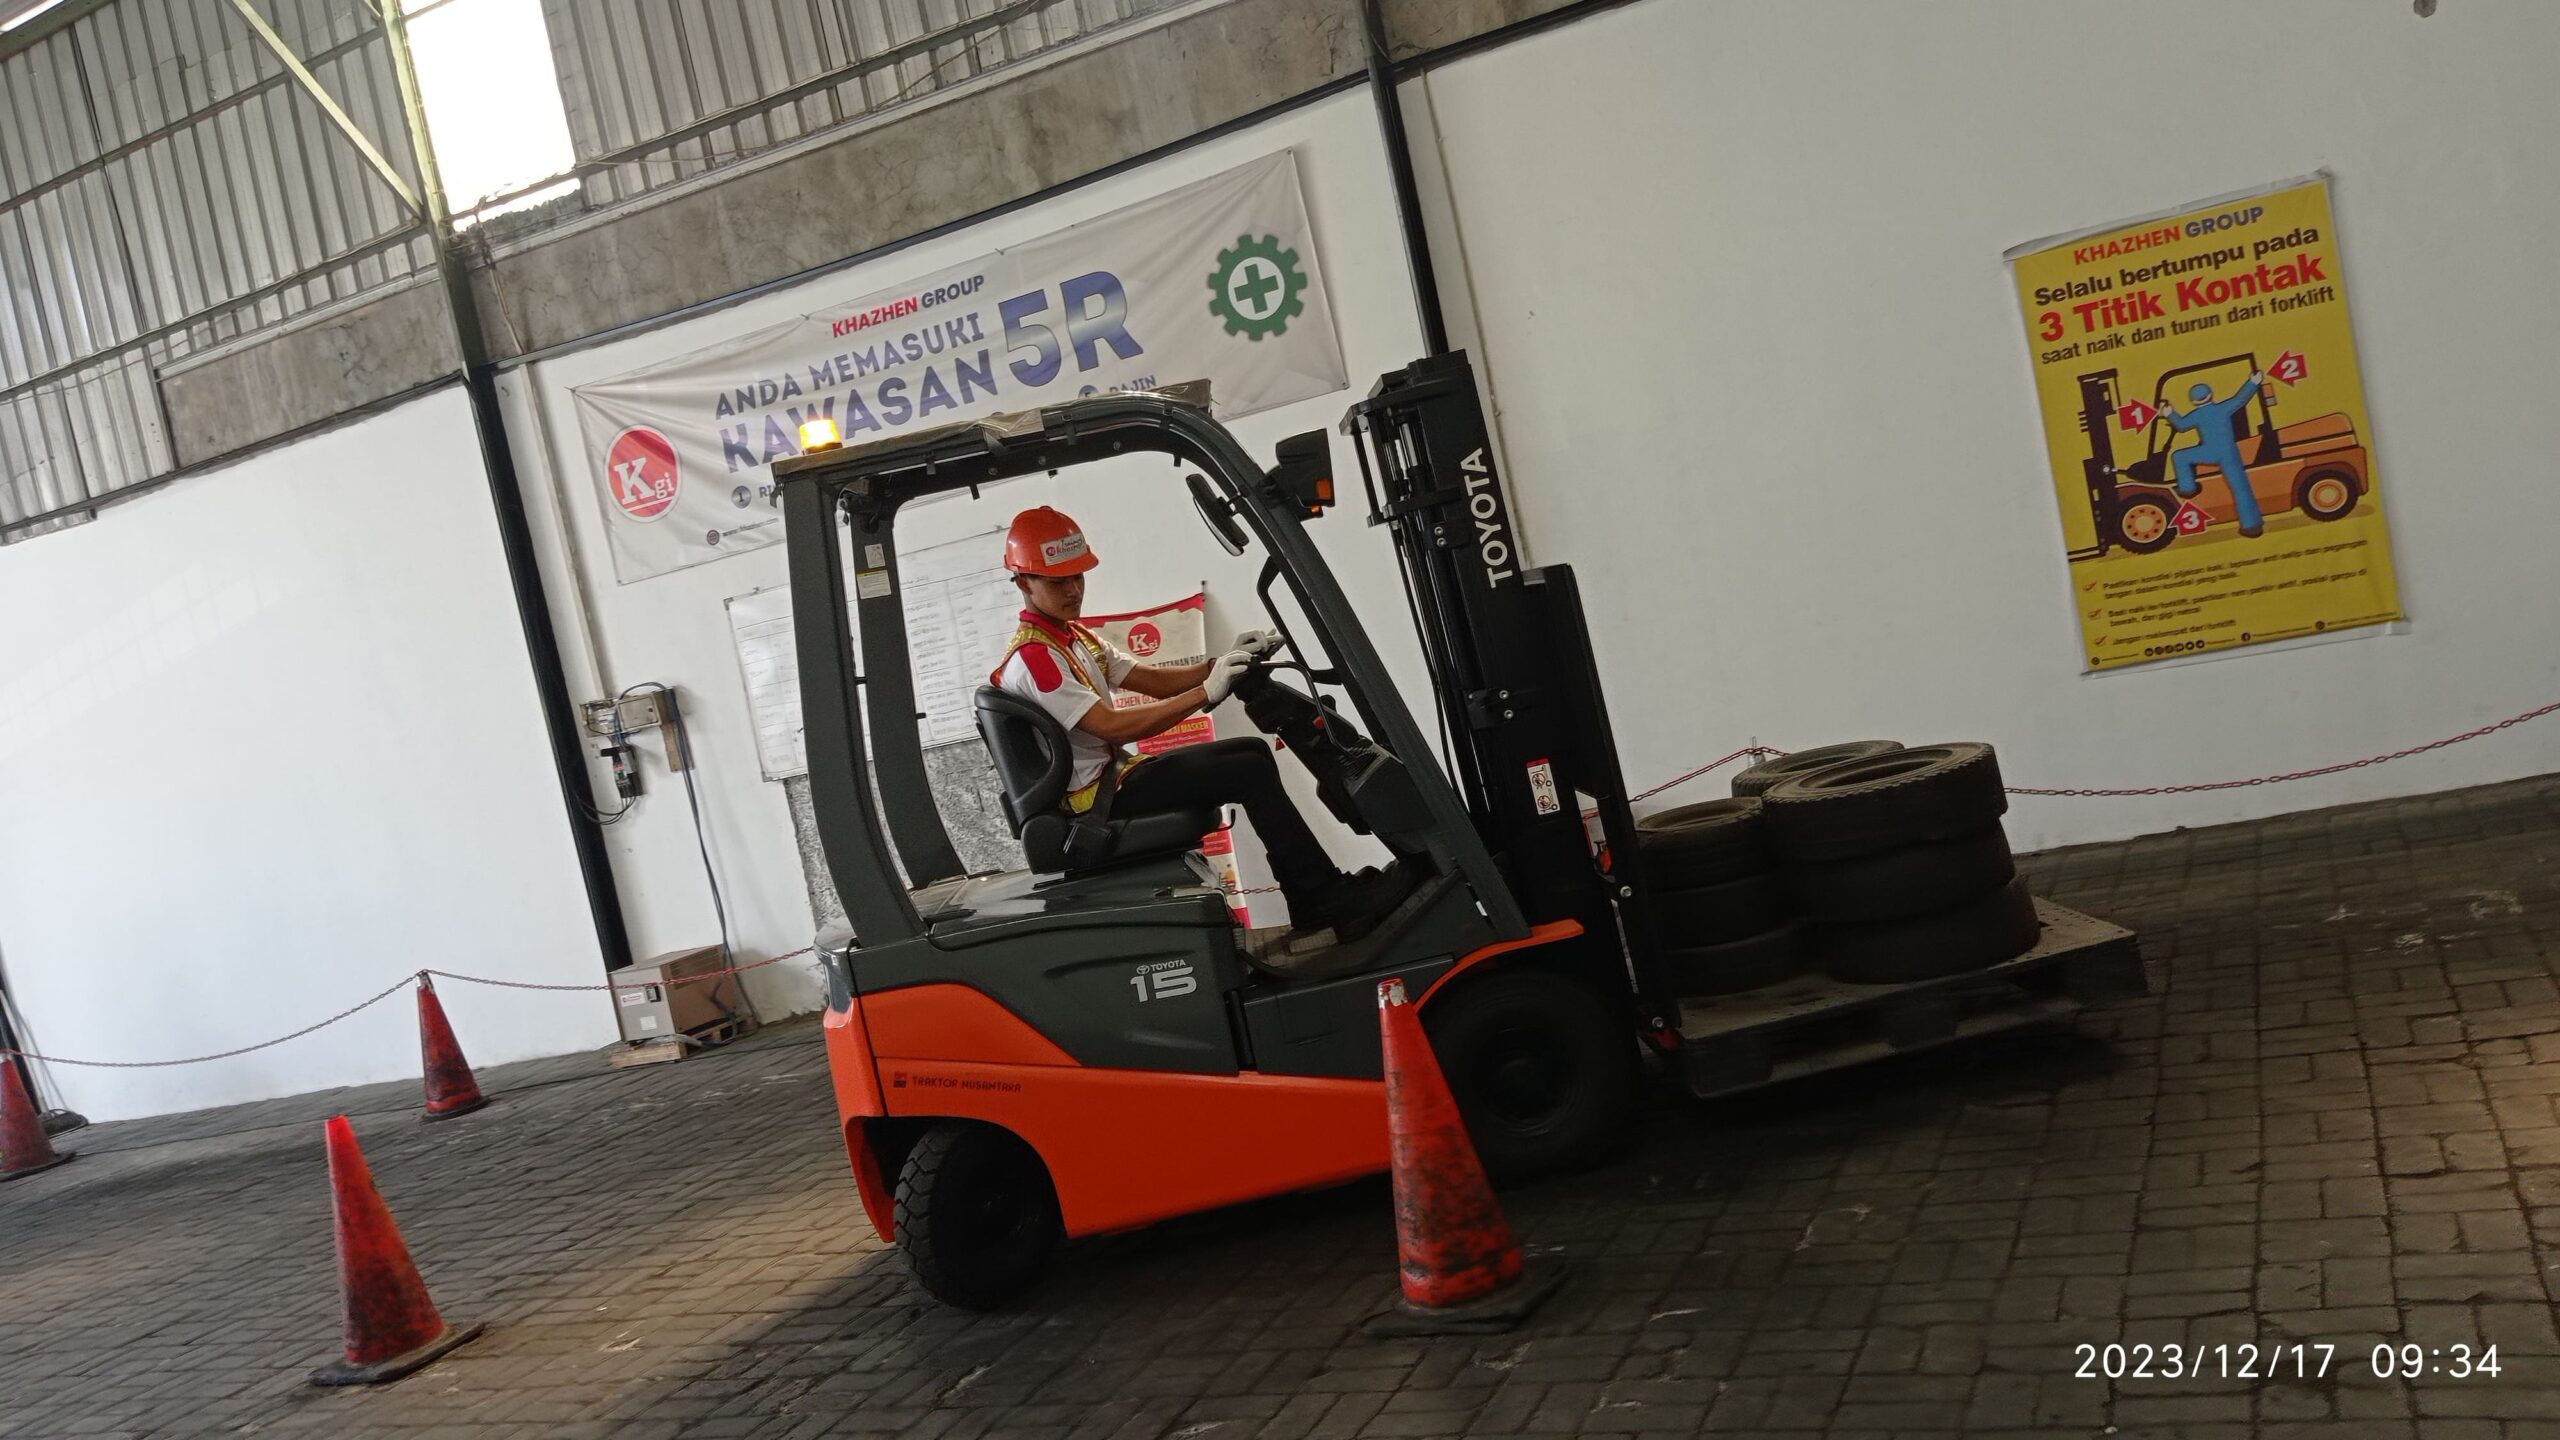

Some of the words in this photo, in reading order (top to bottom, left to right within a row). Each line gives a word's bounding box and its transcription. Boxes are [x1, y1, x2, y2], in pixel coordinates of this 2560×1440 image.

[2074, 225, 2182, 265] KHAZHEN
[2185, 205, 2264, 238] GROUP
[2034, 277, 2112, 306] Selalu
[2120, 246, 2245, 289] bertumpu
[2254, 227, 2319, 261] pada
[832, 296, 918, 338] KHAZHEN
[921, 275, 985, 309] GROUP
[2039, 312, 2065, 342] 3
[2074, 288, 2165, 334] Titik
[2176, 253, 2327, 311] Kontak
[2041, 344, 2082, 365] saat
[2087, 333, 2125, 355] naik
[2131, 325, 2165, 346] dan
[2171, 314, 2220, 336] turun
[2228, 303, 2264, 325] dari
[2271, 285, 2335, 315] forklift
[998, 271, 1144, 388] 5R
[715, 373, 803, 420] ANDA
[808, 312, 985, 391] MEMASUKI
[2281, 358, 2300, 378] 2
[2130, 406, 2145, 425] 1
[614, 456, 675, 506] Kgi
[1460, 447, 1513, 589] TOYOTA
[2181, 511, 2199, 530] 3
[1130, 966, 1197, 1002] 15
[1150, 959, 1186, 972] TOYOTA
[912, 1076, 958, 1088] TRAKTOR
[962, 1081, 1021, 1092] NUSANTARA
